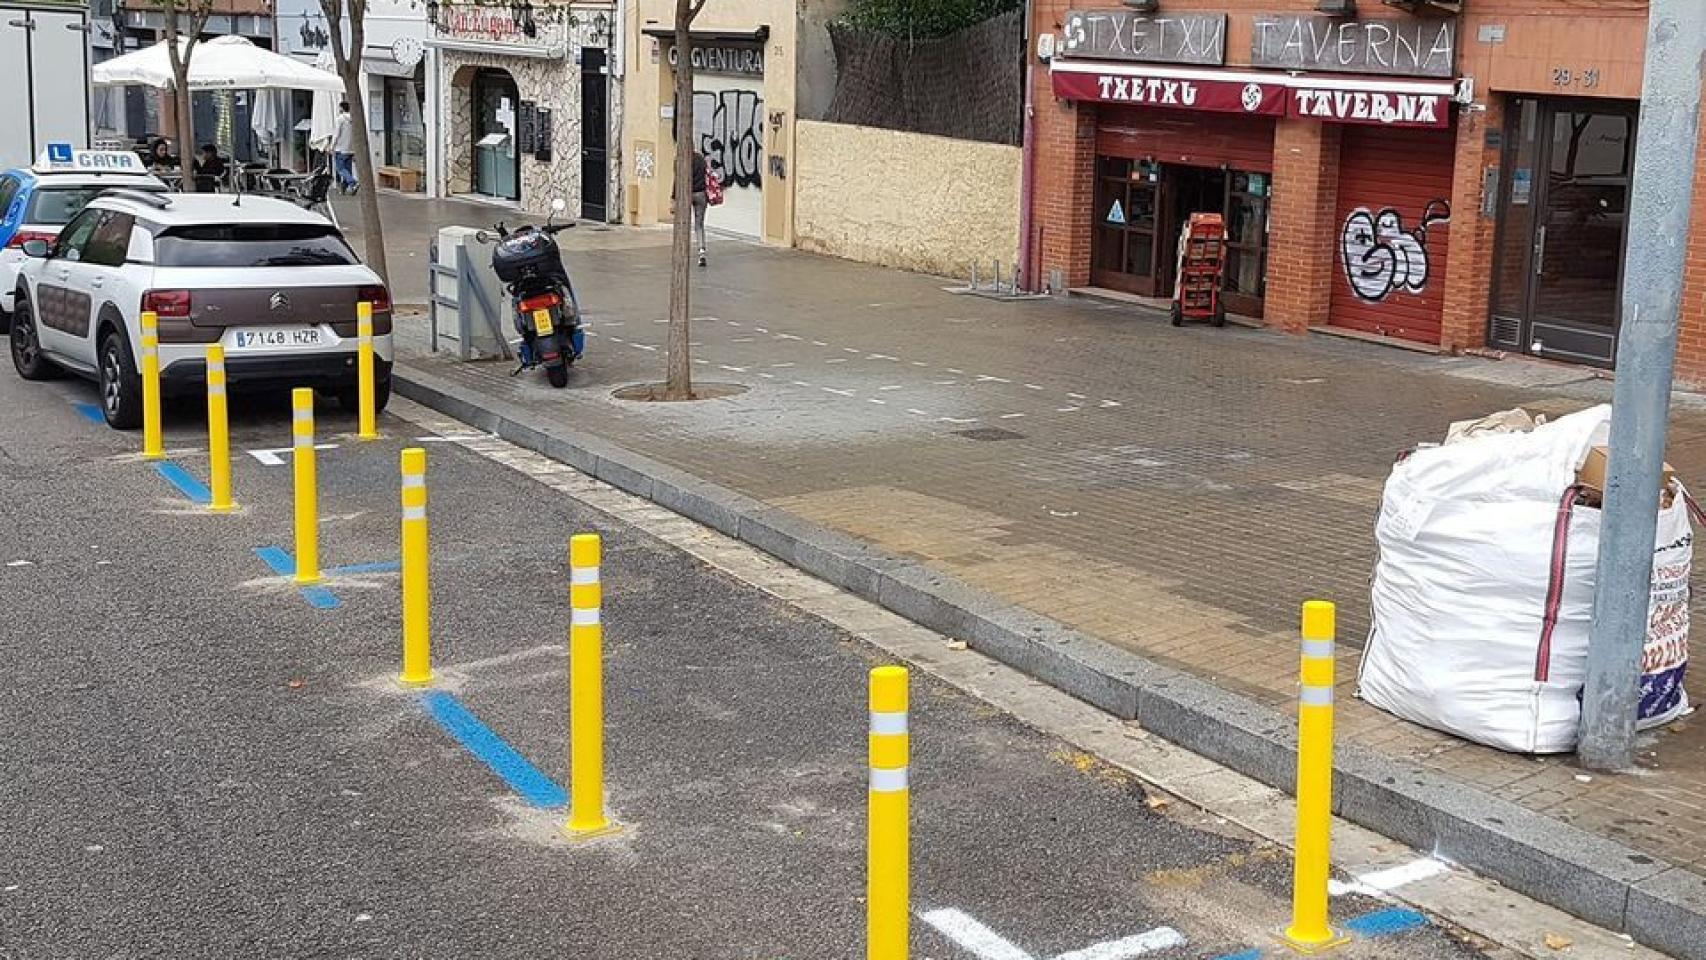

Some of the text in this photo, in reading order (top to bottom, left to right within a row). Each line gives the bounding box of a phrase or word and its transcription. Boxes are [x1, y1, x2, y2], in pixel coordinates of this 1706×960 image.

[1087, 15, 1222, 61] TXETXU
[1255, 18, 1452, 68] TAVERNA
[1097, 75, 1198, 106] TXETXU
[1295, 89, 1438, 122] TAVERNA
[291, 329, 320, 344] HZR
